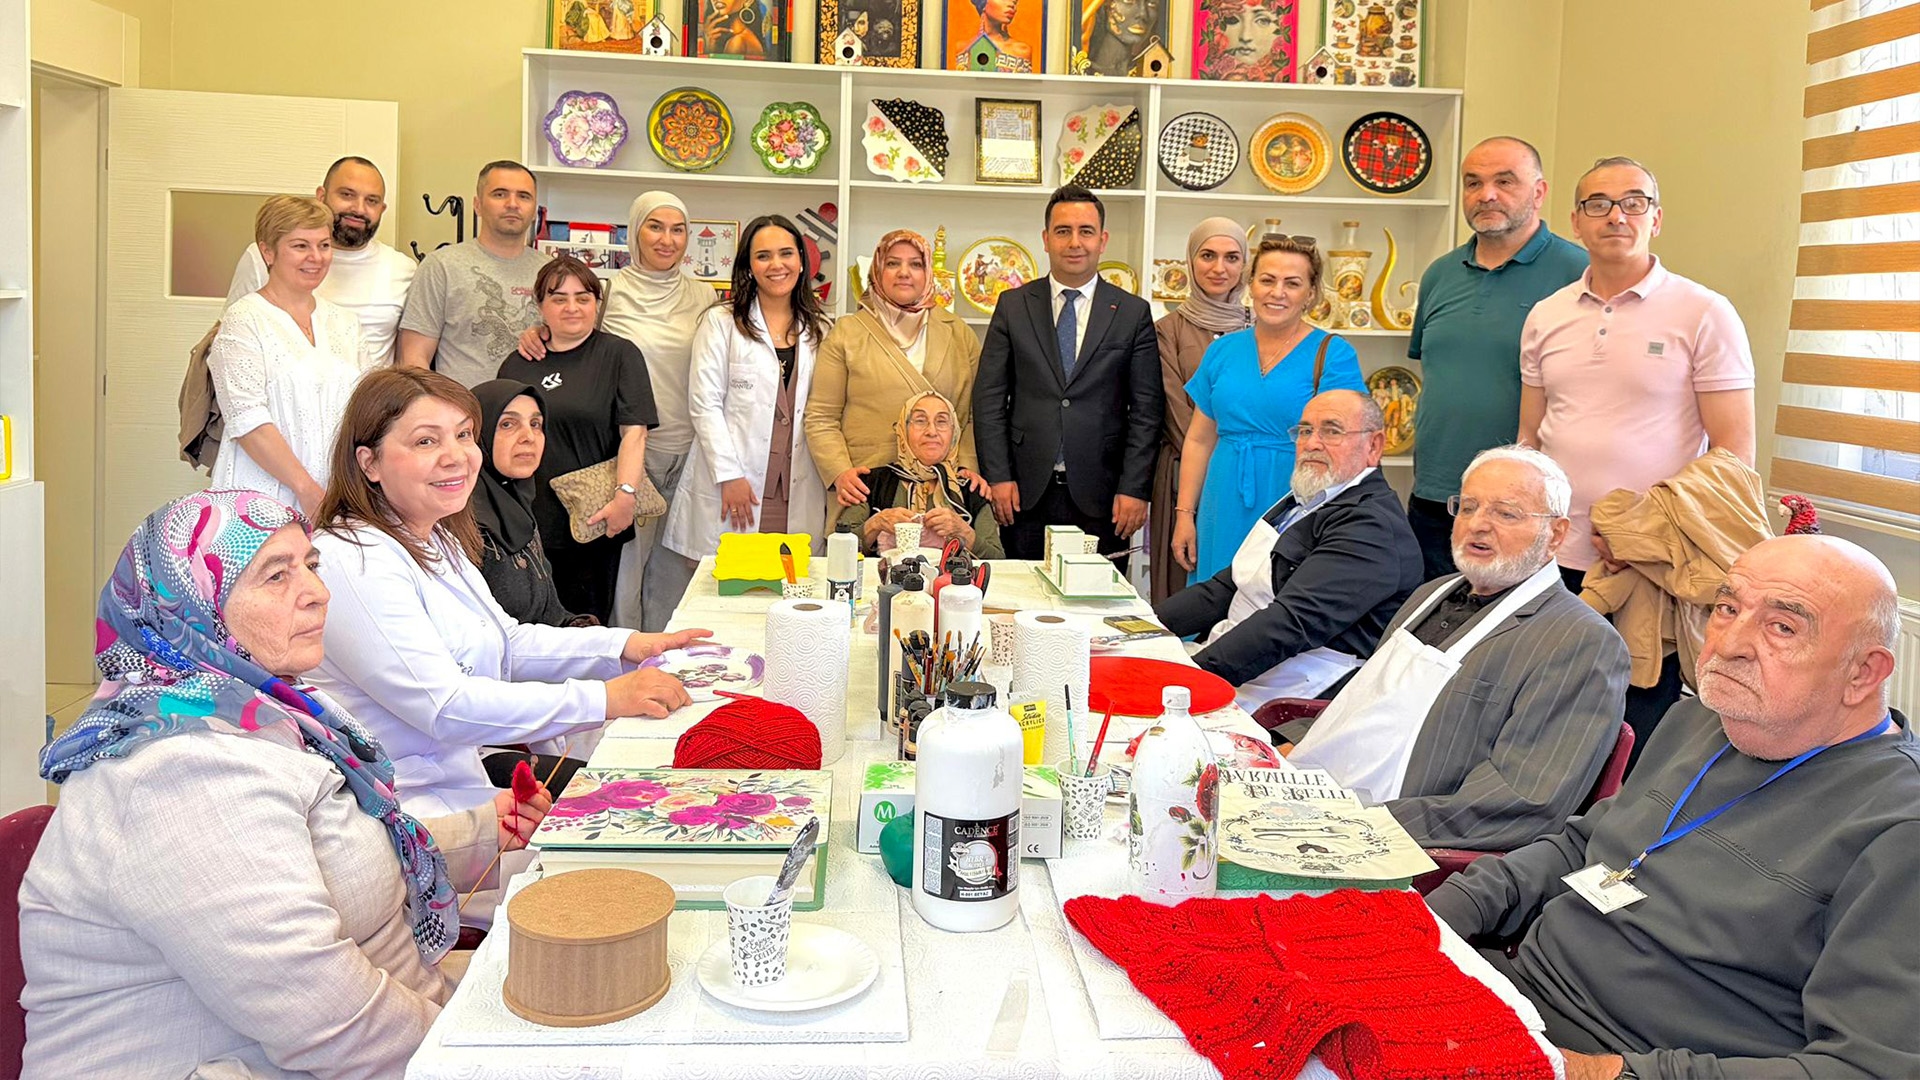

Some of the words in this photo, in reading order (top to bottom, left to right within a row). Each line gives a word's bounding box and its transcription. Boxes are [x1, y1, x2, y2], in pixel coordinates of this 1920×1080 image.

[876, 803, 893, 819] M
[954, 824, 998, 837] CADENCE
[1027, 843, 1039, 853] CE
